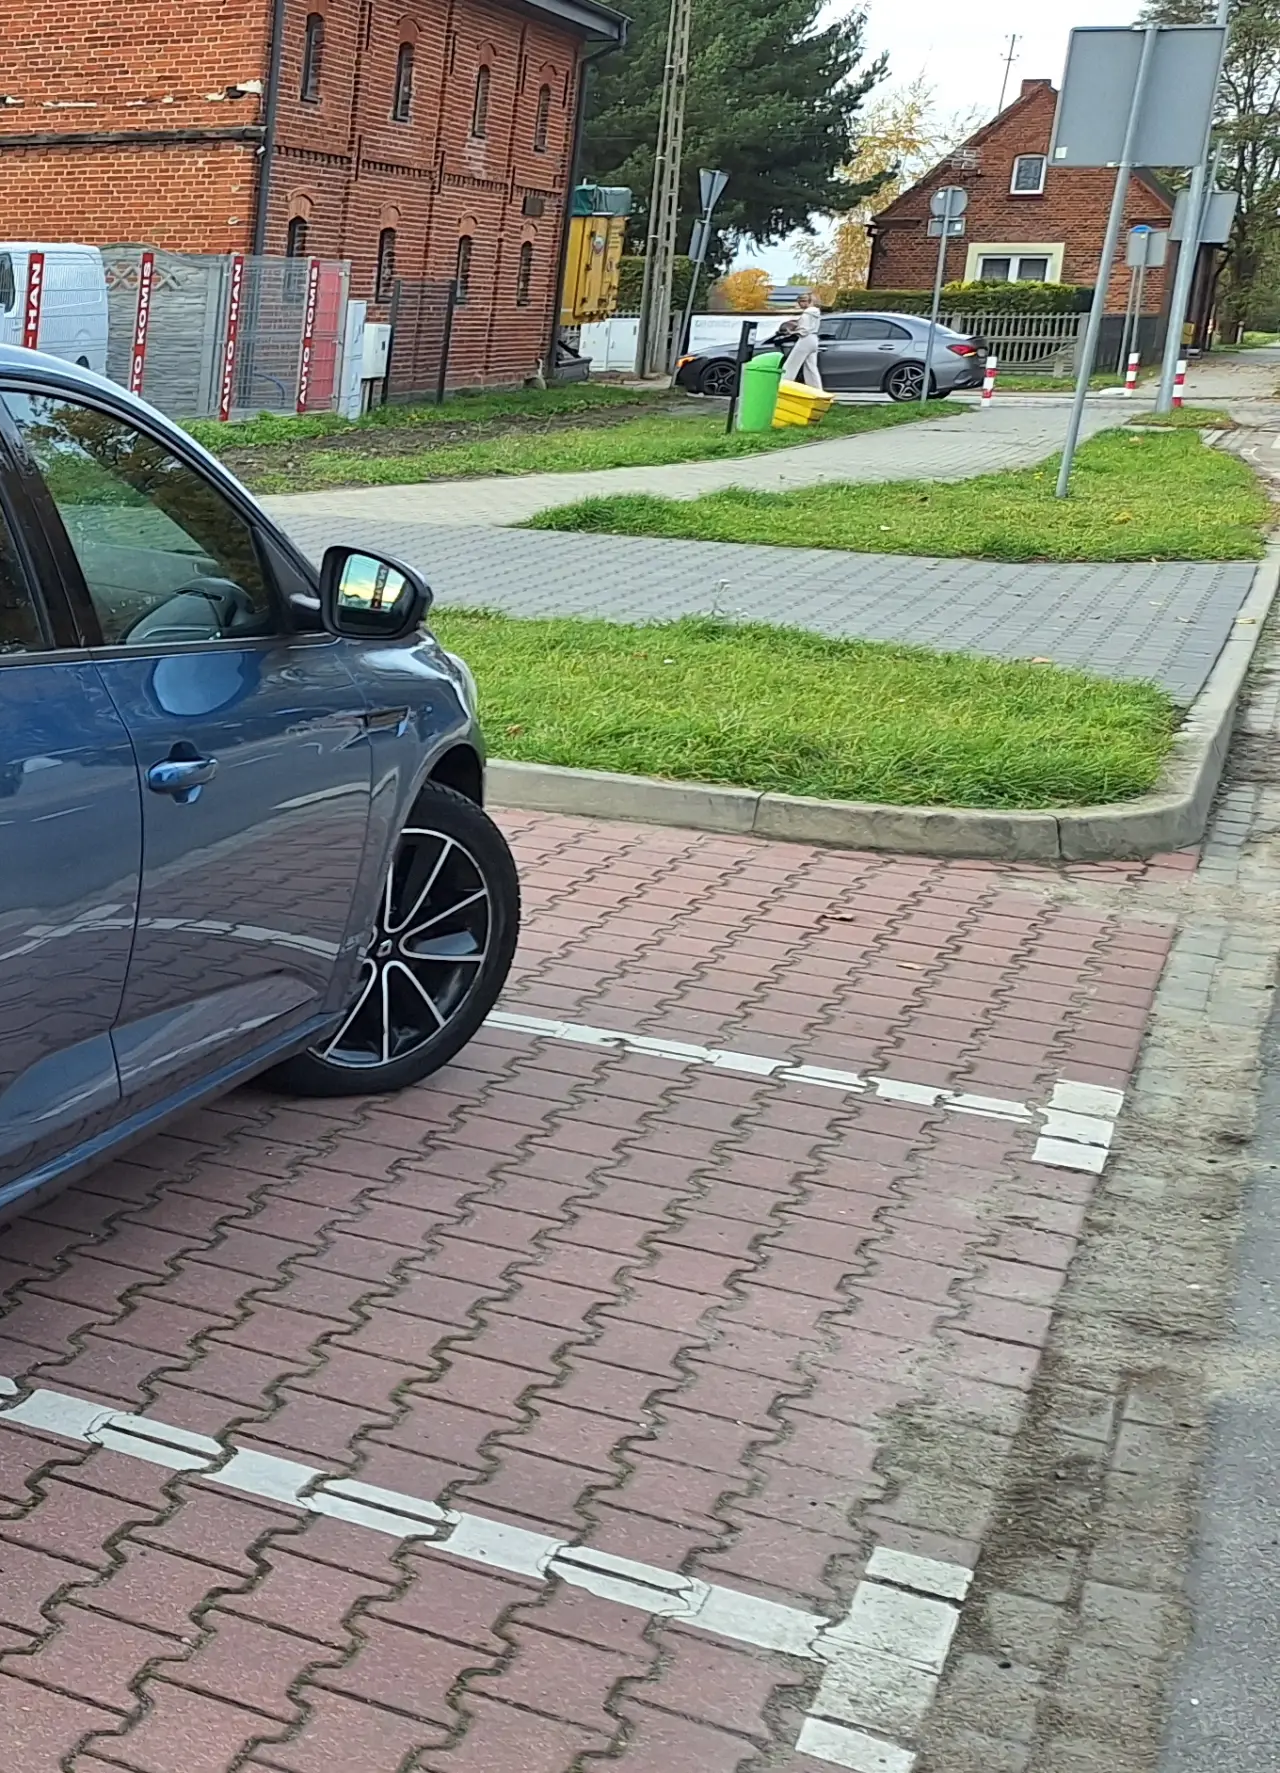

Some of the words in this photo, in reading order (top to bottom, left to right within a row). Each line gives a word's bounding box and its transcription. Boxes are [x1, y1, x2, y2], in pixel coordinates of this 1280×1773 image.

[27, 263, 42, 330] HAN
[137, 262, 152, 345] KOMIS
[299, 347, 310, 404] AUTO
[306, 267, 318, 338] KOMIS
[132, 355, 143, 396] TO
[222, 340, 234, 413] AUTO
[230, 264, 242, 321] HAN
